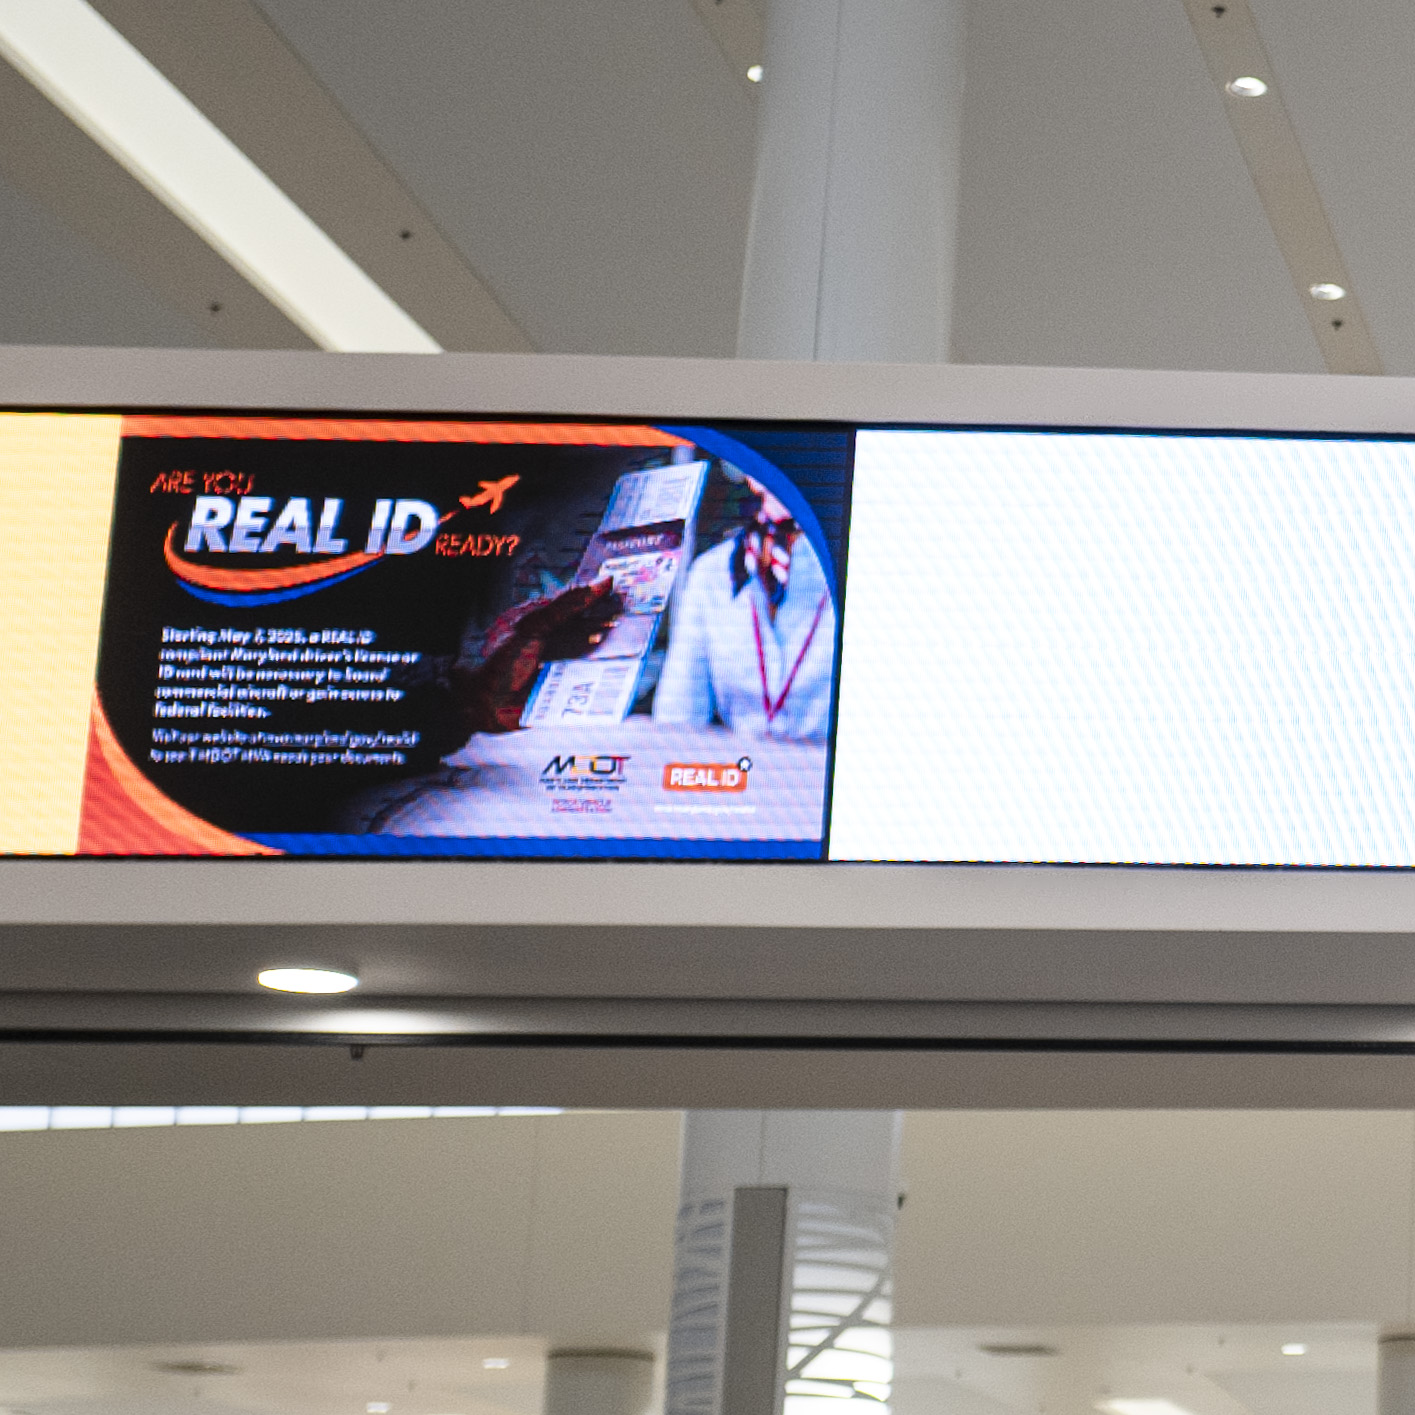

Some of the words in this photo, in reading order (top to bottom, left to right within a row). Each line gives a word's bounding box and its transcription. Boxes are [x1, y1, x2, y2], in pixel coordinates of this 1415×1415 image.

[150, 471, 197, 495] ARE
[202, 471, 255, 496] YOU
[184, 494, 349, 554] REAL
[363, 497, 441, 555] ID
[435, 533, 521, 557] READY?
[670, 767, 719, 787] REAL
[721, 768, 740, 787] ID
